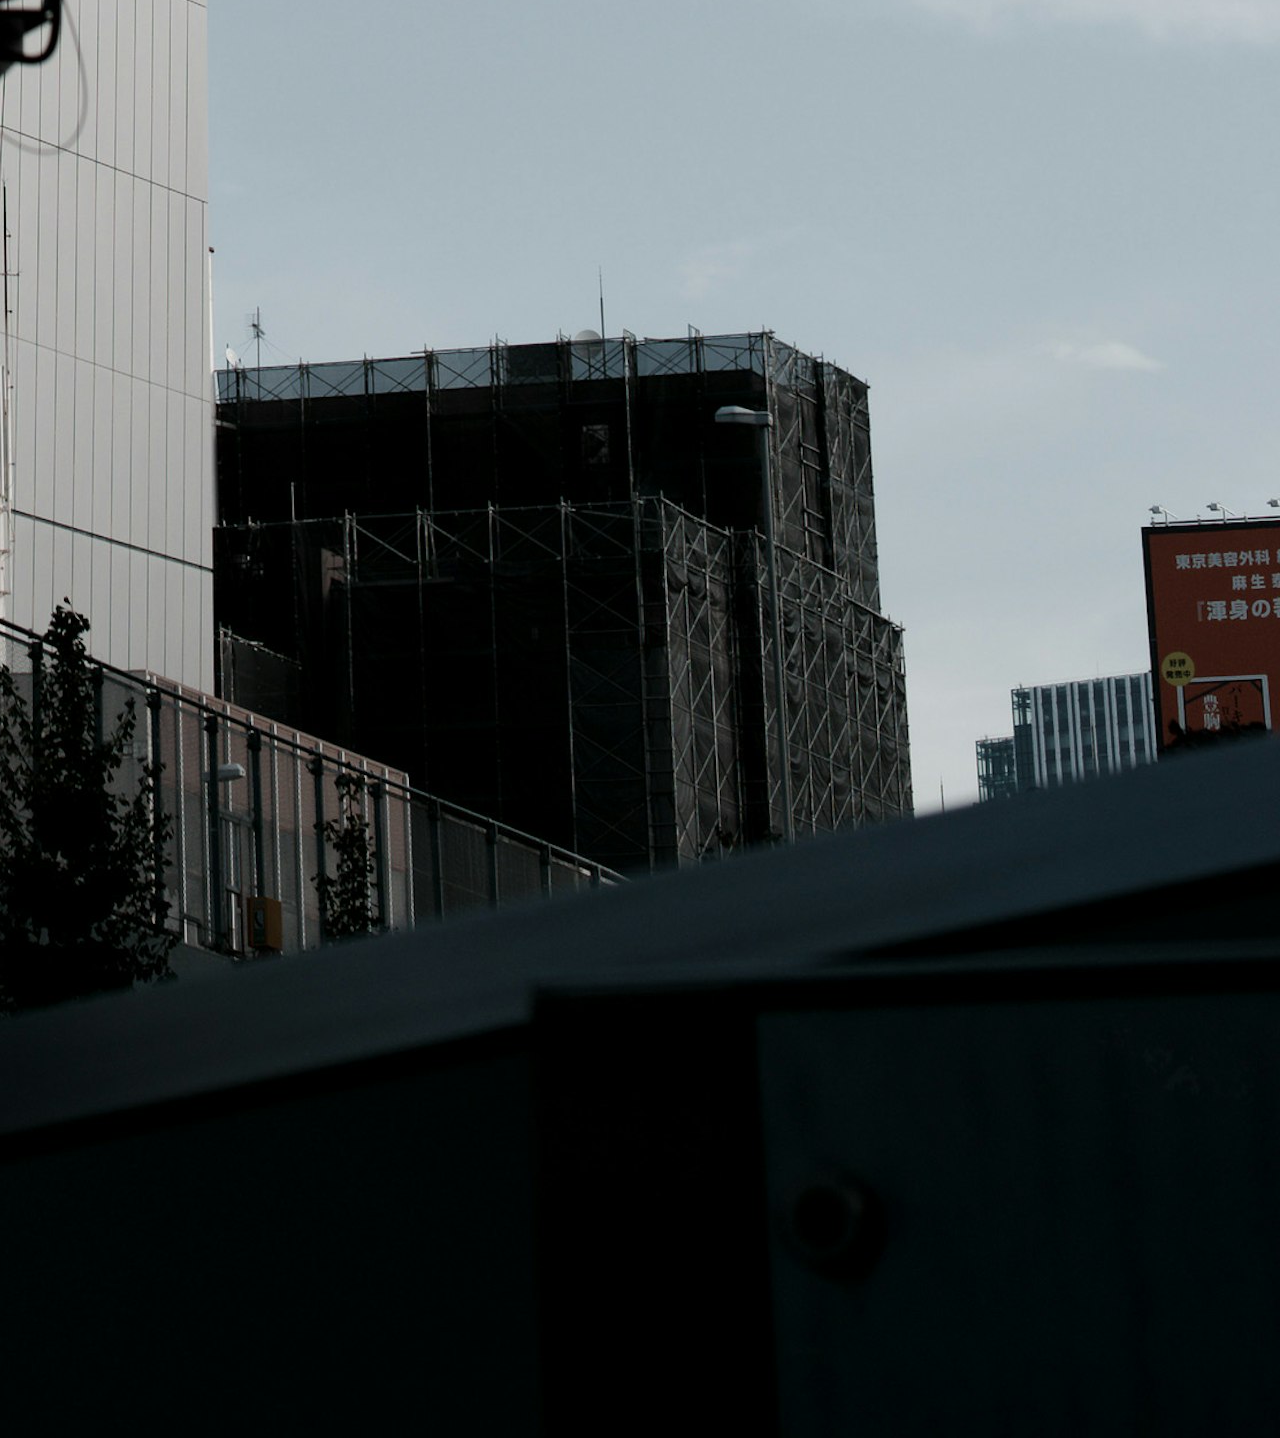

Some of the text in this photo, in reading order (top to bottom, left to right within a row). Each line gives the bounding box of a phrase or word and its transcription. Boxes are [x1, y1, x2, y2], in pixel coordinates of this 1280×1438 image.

[1175, 549, 1270, 570] 東京美容外科
